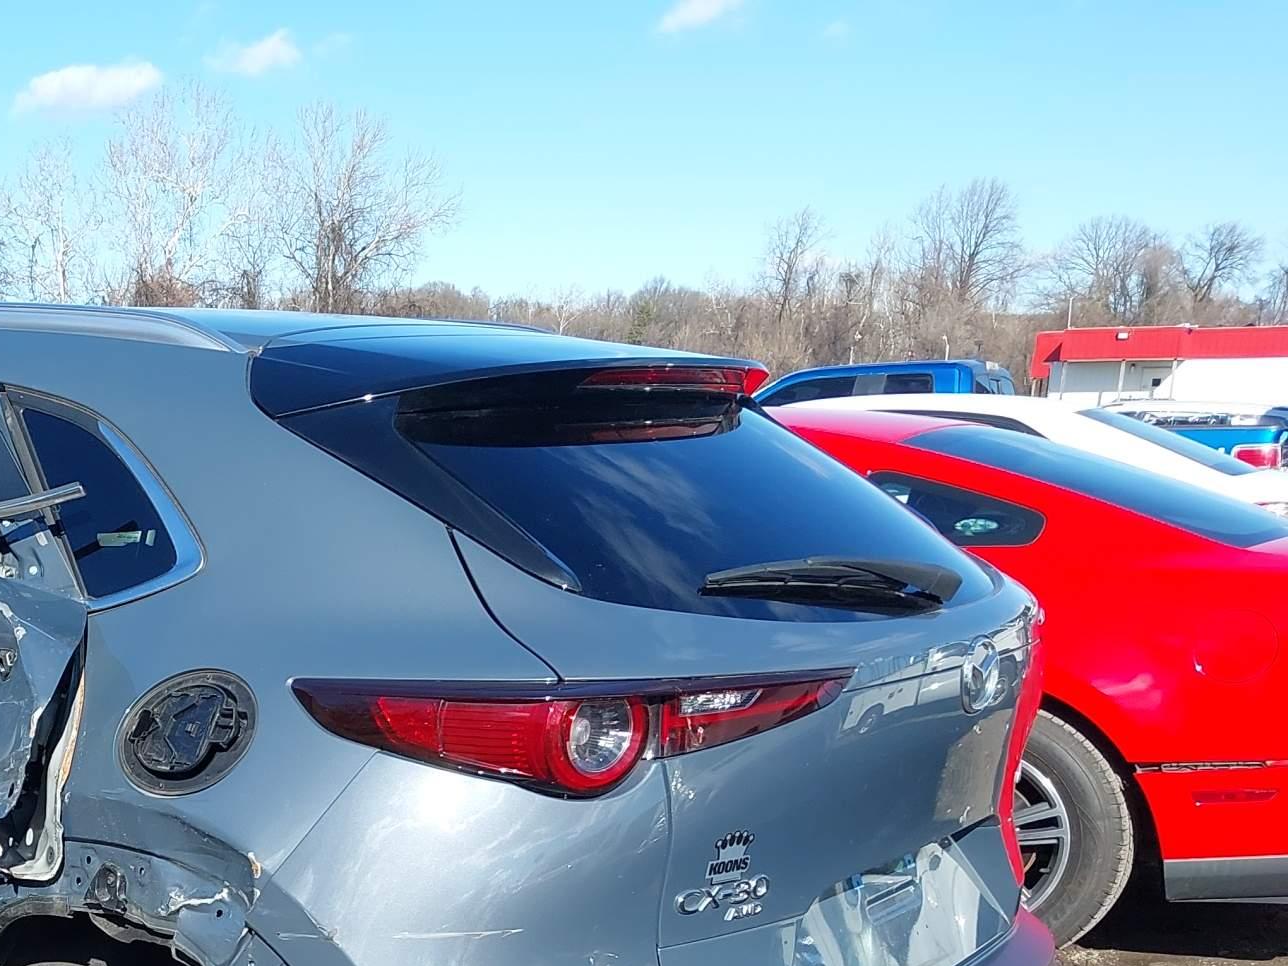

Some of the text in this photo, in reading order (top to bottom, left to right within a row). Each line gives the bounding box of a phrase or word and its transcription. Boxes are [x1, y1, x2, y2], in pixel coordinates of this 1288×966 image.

[708, 856, 749, 875] KOONS
[674, 874, 769, 915] CX-30
[724, 902, 762, 921] AWD
